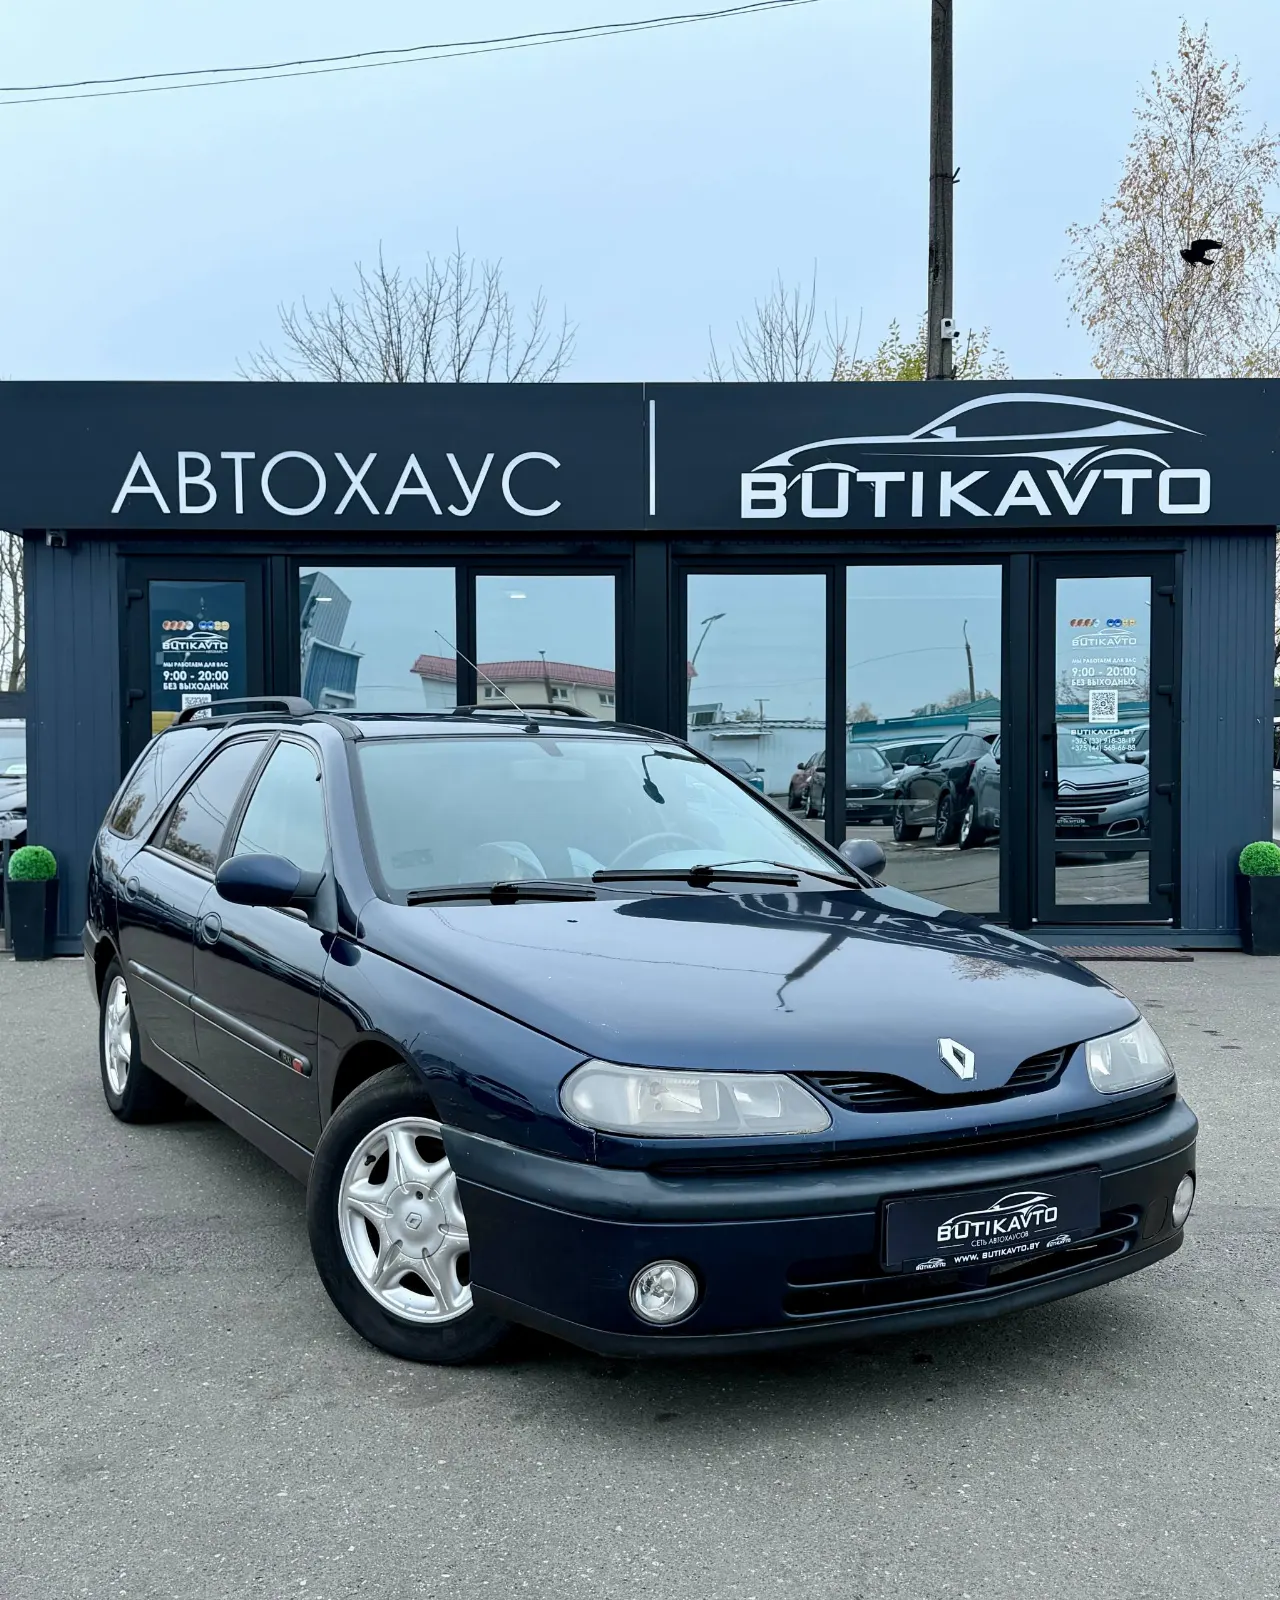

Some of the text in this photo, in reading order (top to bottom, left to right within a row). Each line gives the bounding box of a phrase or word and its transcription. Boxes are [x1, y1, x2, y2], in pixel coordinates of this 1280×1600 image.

[111, 450, 562, 517] АВТОХАУС
[740, 467, 1211, 519] BUTIKAVTO
[162, 642, 228, 650] BUTIKAVTO
[1072, 638, 1136, 646] BUTIKAVTO
[163, 671, 187, 681] 9:00
[198, 671, 229, 681] 20:00
[1072, 667, 1095, 677] 9:00
[1107, 666, 1137, 676] 20:00
[179, 682, 229, 691] ВЫХОДНЫХ
[937, 1207, 1058, 1242] BUTIKAVTO
[971, 1231, 1029, 1247] СЕТЬ АВТОХАУСОВ
[954, 1241, 1040, 1263] WWW. BUTIKAVTO.BY
